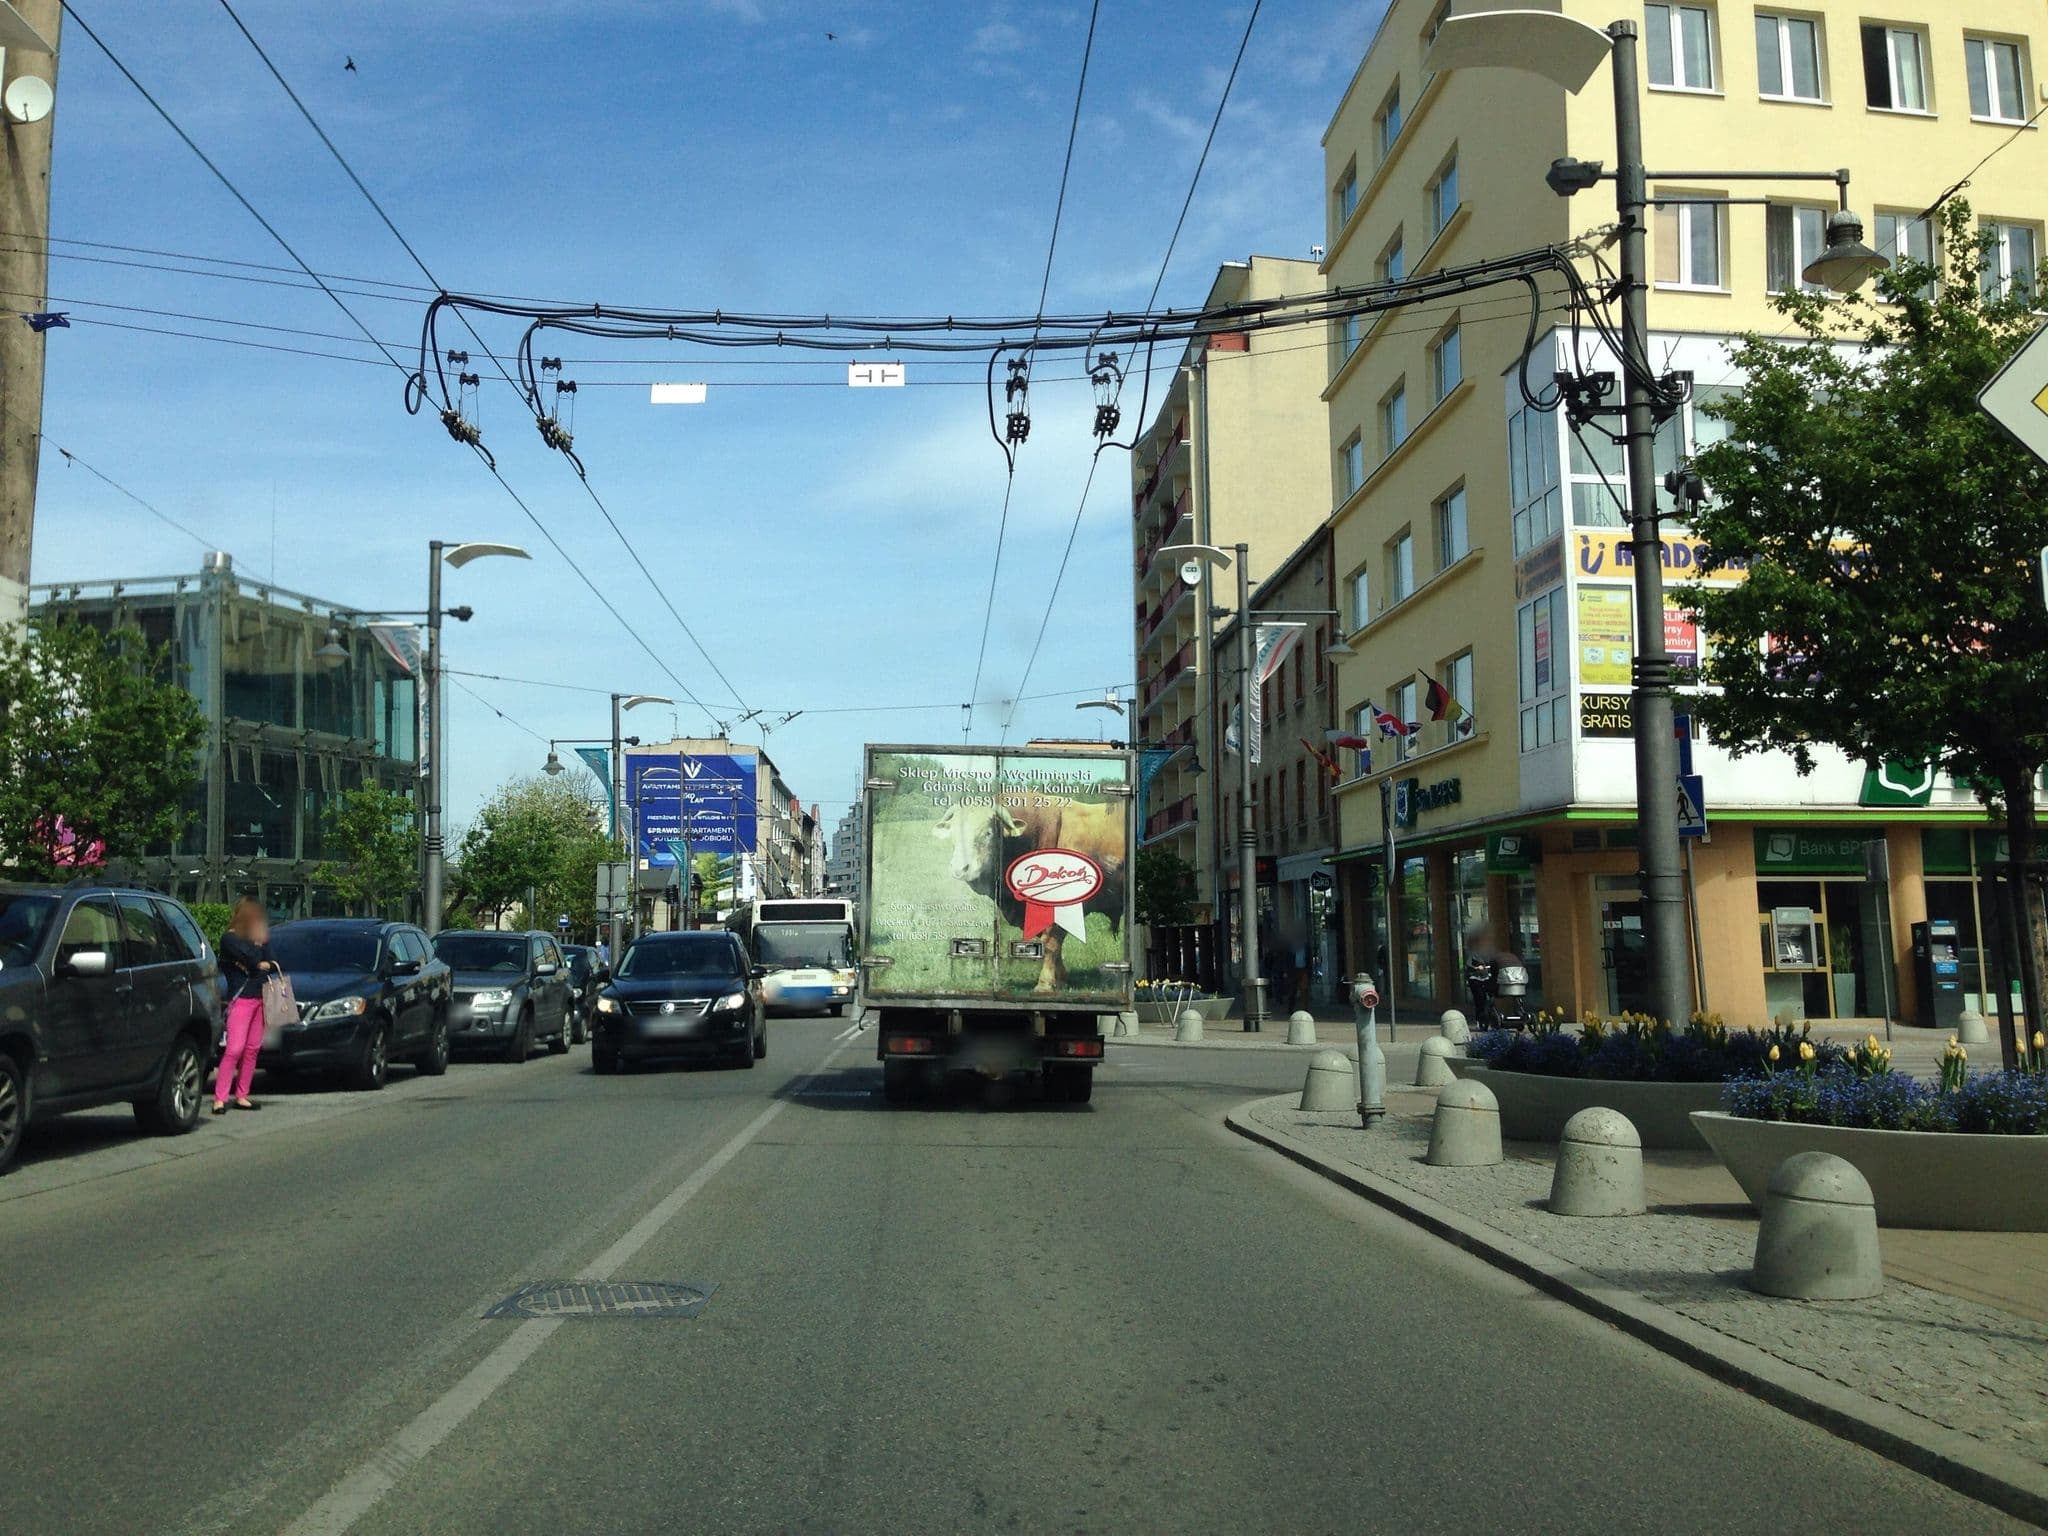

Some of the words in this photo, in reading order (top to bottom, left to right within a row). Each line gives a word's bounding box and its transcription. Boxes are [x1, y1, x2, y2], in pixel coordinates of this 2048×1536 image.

[1580, 696, 1631, 711] KURSY
[1580, 714, 1632, 729] GRATIS
[898, 767, 938, 780] Sklep
[1032, 786, 1039, 794] z
[959, 796, 996, 808] (058)
[1002, 797, 1027, 807] 301
[1033, 797, 1051, 807] 25
[1055, 797, 1073, 808] 22
[1799, 840, 1836, 855] Bank
